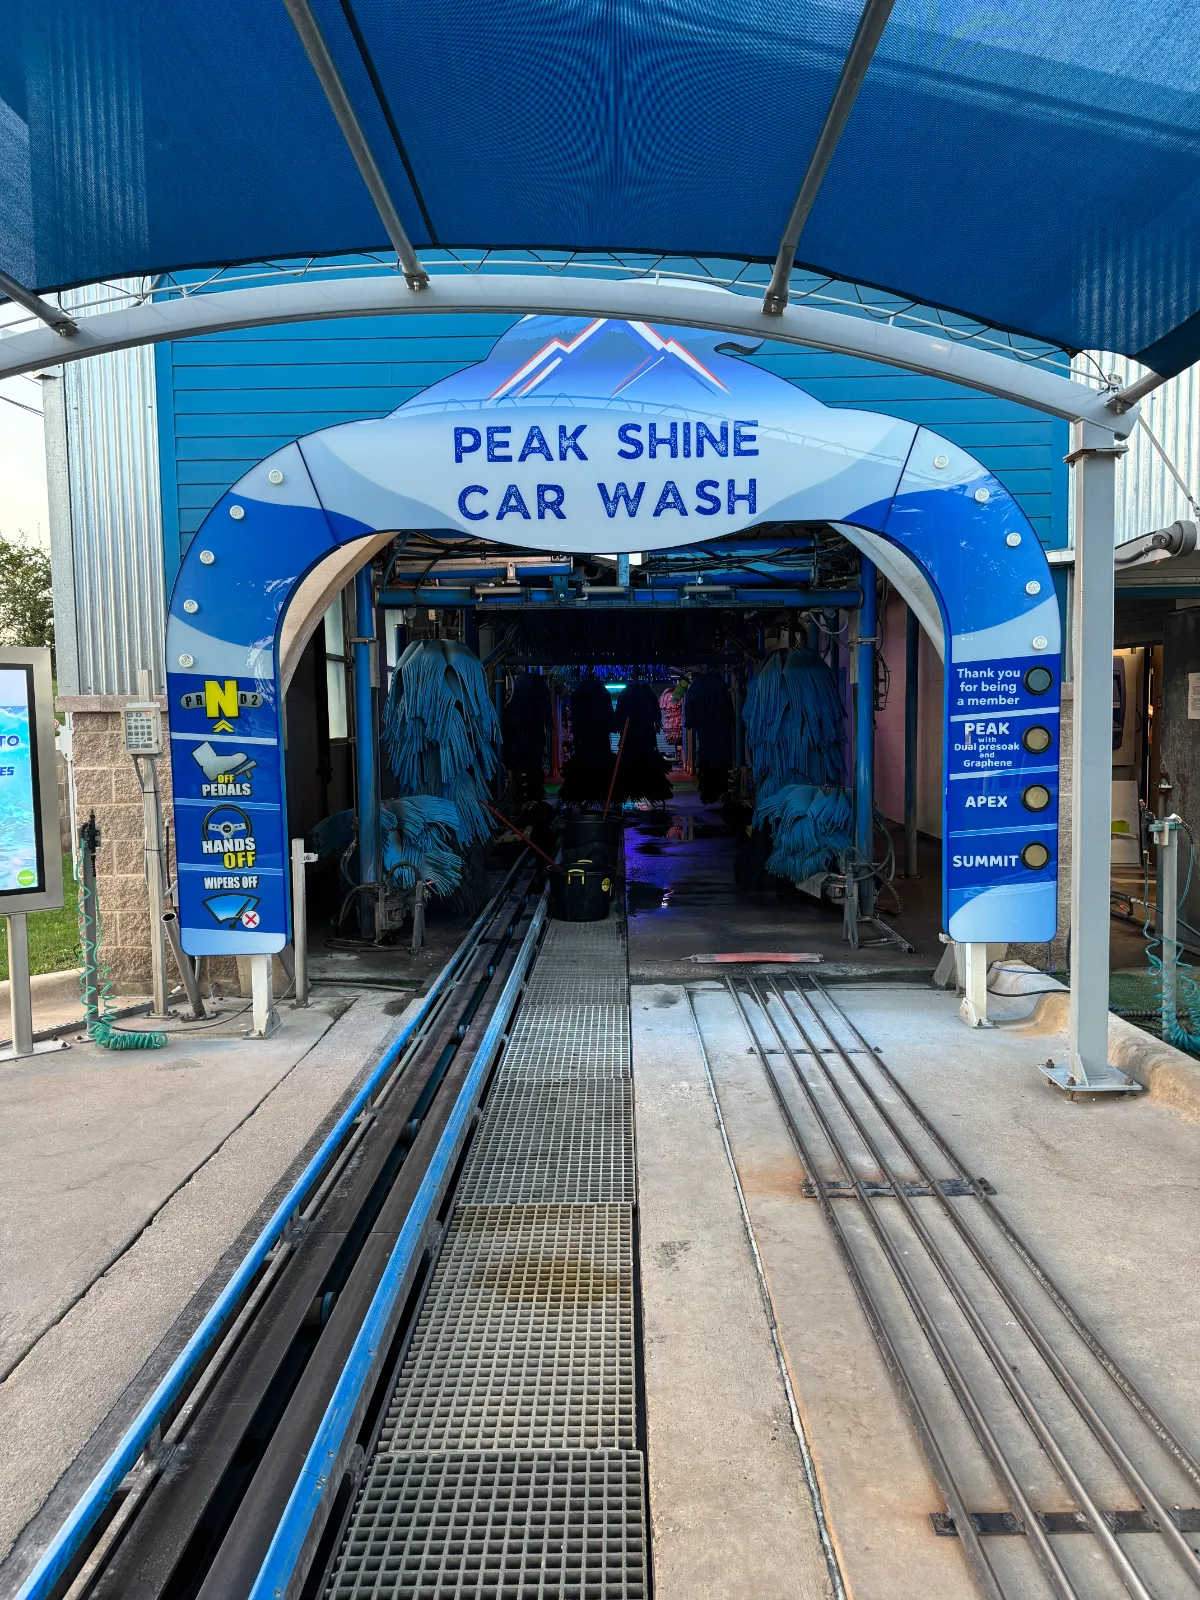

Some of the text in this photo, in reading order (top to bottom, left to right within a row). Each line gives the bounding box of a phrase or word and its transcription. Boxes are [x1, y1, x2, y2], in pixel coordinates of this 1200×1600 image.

[454, 420, 759, 463] PEAK SHINE
[457, 478, 757, 521] CAR WASH
[957, 668, 1020, 680] Thank you
[960, 681, 1016, 694] for being
[968, 695, 1020, 705] member
[964, 722, 1010, 735] PEAK
[954, 742, 1020, 752] Dual presoak
[963, 759, 1013, 768] Graphene
[217, 775, 235, 784] OFF
[202, 784, 252, 797] PEDALS
[965, 796, 1008, 808] APEX
[202, 837, 256, 854] HANDS
[223, 851, 256, 869] OFF
[952, 855, 1019, 867] SUMMIT
[204, 875, 258, 890] WIPERS OFF
